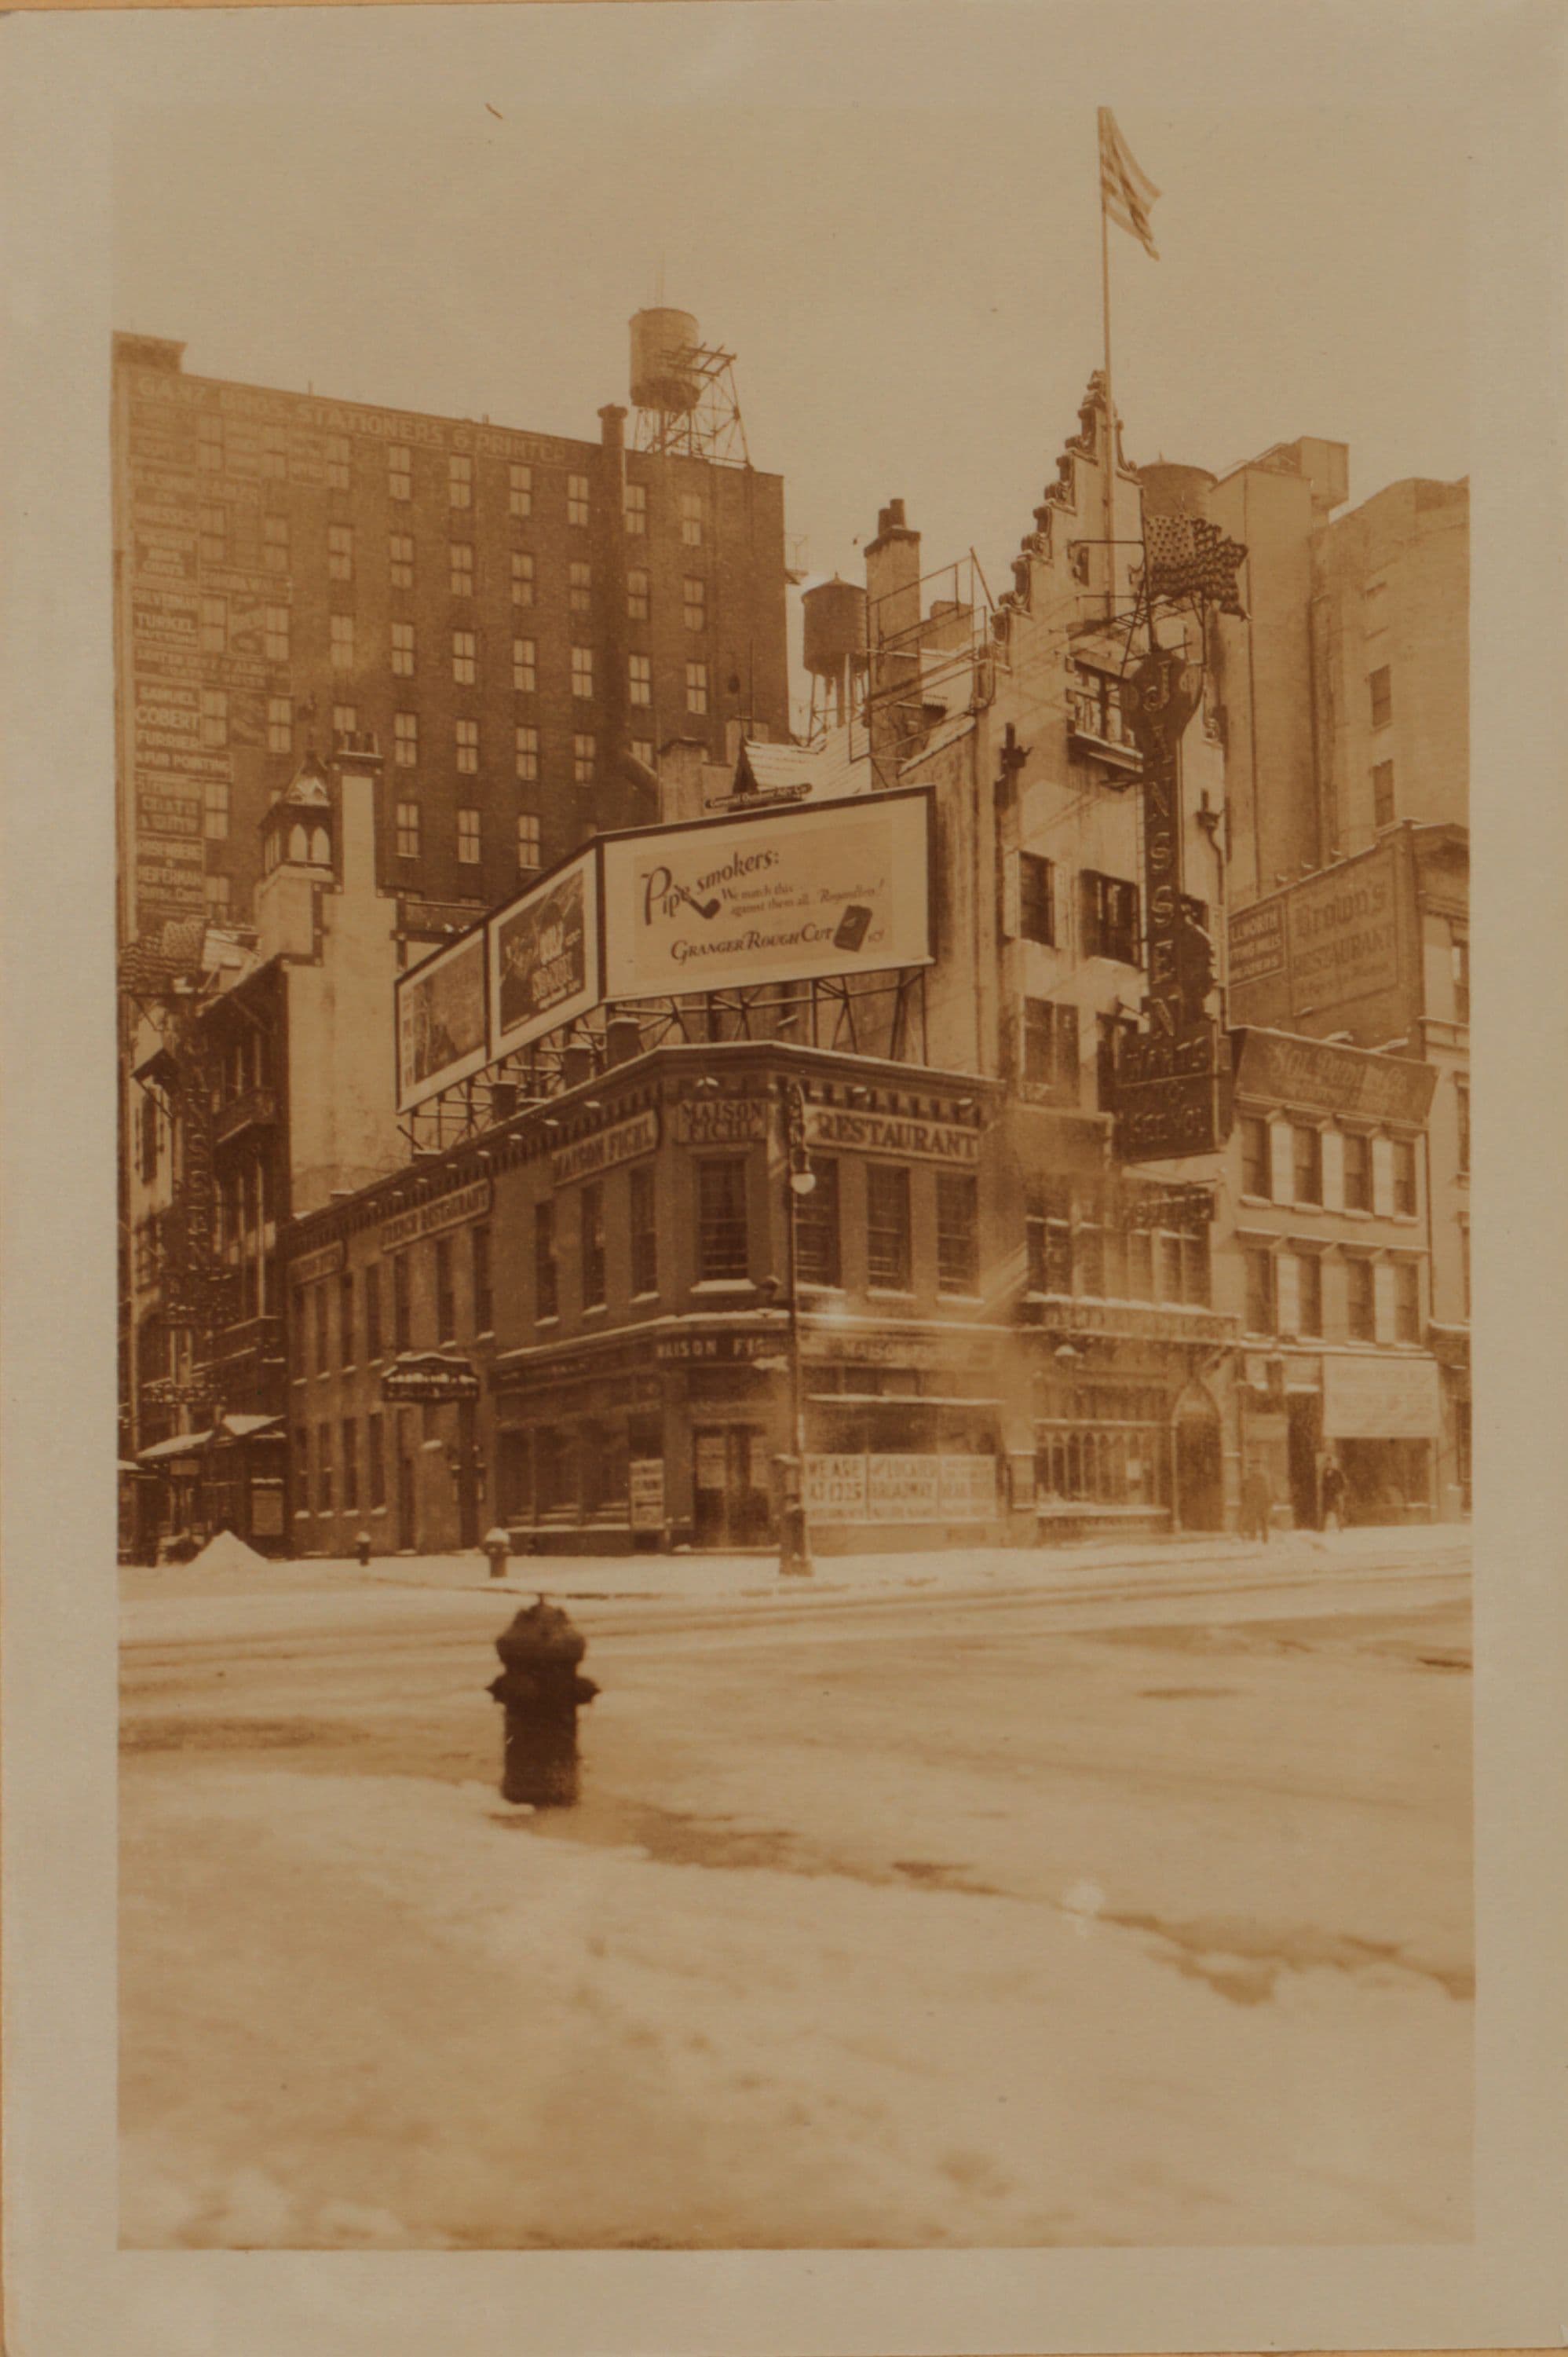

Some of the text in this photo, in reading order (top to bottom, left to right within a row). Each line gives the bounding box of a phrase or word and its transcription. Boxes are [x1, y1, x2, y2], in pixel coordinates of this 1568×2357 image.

[296, 403, 444, 443] STATIONERS
[696, 849, 780, 891] smokers:
[681, 1101, 762, 1122] MAISON
[816, 1112, 979, 1157] RESTAURANT
[656, 1339, 717, 1358] MAISON
